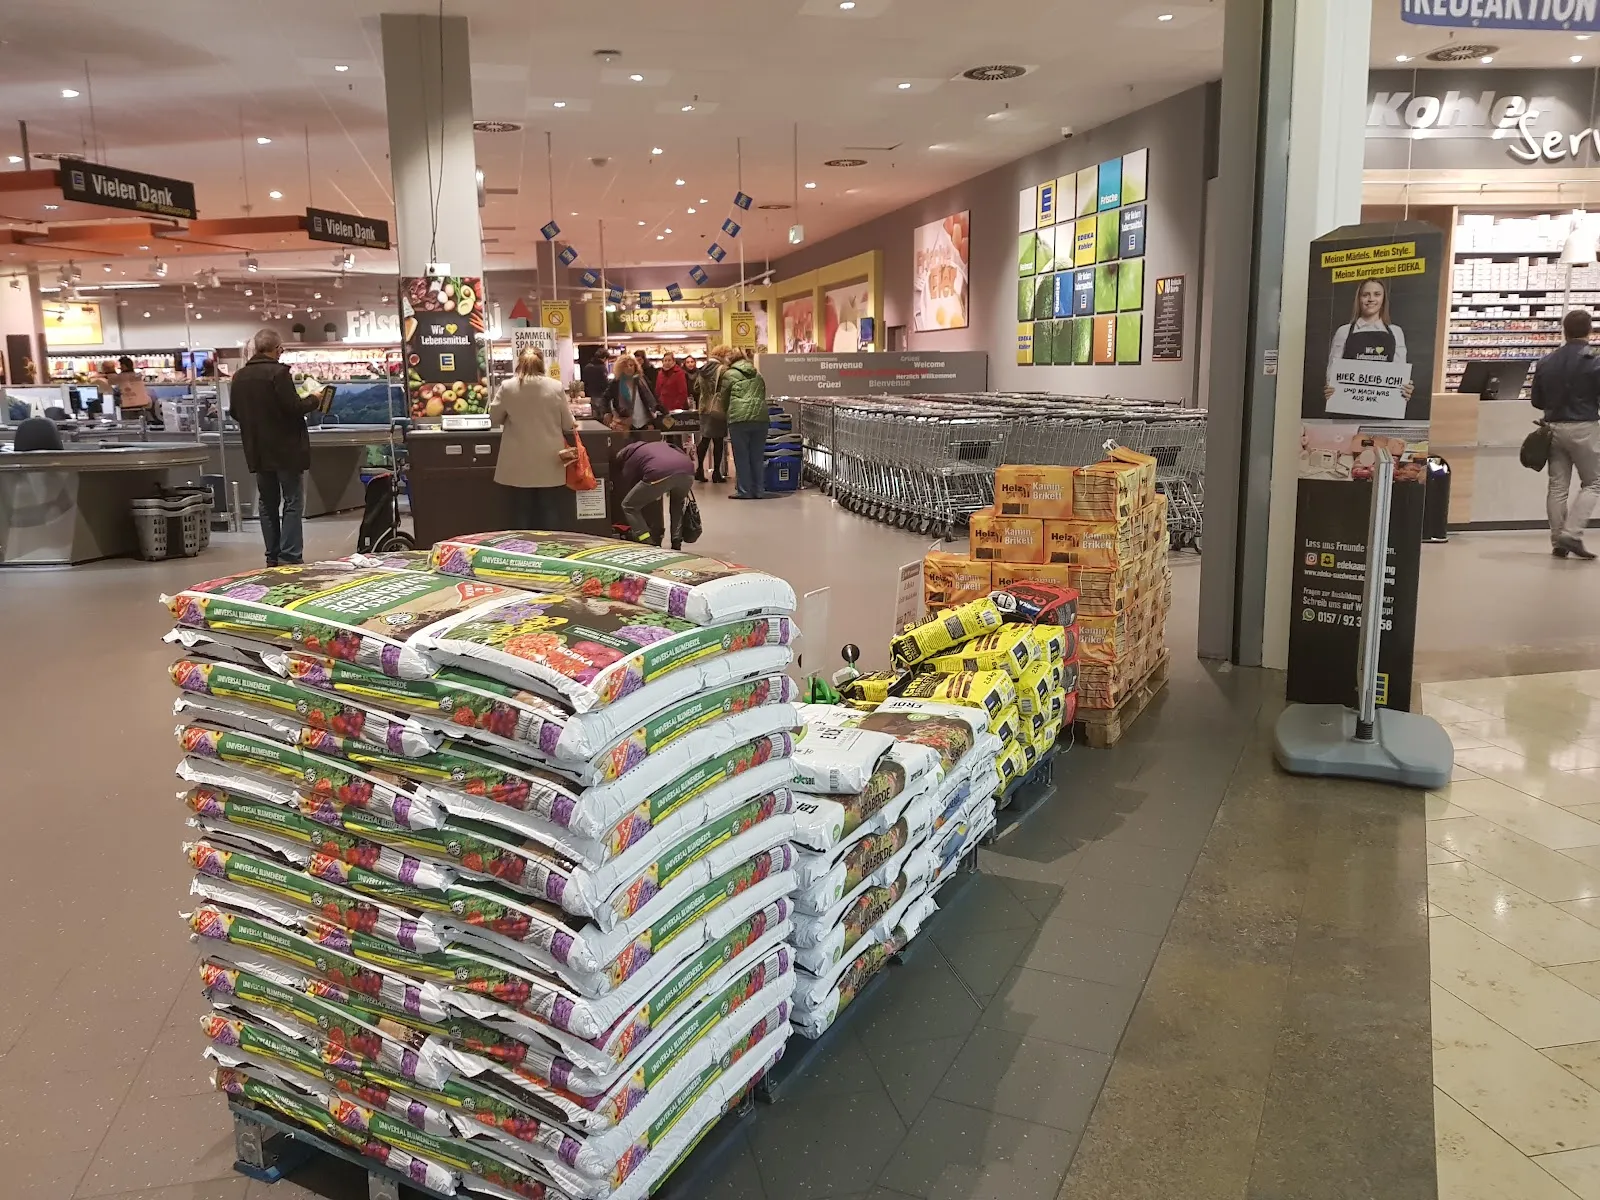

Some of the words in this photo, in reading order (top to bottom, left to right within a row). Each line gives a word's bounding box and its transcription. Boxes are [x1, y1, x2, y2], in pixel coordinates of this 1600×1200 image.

[92, 174, 137, 201] Vielen
[139, 182, 174, 207] Dank
[326, 218, 354, 238] Vielen
[355, 222, 376, 241] Dank
[1077, 232, 1094, 243] EDEKA
[1324, 255, 1345, 265] Meine
[1345, 252, 1372, 262] Mädels.
[1373, 249, 1391, 258] Mein
[1391, 247, 1412, 257] Style.
[1334, 270, 1356, 280] Meine
[1356, 267, 1385, 278] Karriere
[1385, 264, 1397, 273] bei
[430, 324, 446, 336] Wir
[514, 331, 553, 341] SAMMELN,
[421, 335, 472, 346] Lebensmittel.
[514, 340, 545, 349] SPAREN
[820, 361, 863, 370] Bienvenue
[914, 360, 946, 368] Welcome
[788, 374, 826, 383] Welcome
[868, 379, 911, 388] Bienvenue
[1336, 372, 1356, 382] HIER
[1358, 373, 1383, 385] BLEIB
[1385, 376, 1403, 386] ICH!
[1032, 491, 1063, 500] Brikett
[1004, 536, 1034, 545] Brikett
[1082, 540, 1112, 549] Brikett
[1322, 541, 1335, 550] uns
[1336, 541, 1365, 553] Freunde
[481, 556, 509, 566] UNIVERSAL
[1303, 586, 1321, 597] Fragen
[341, 585, 431, 615] UNIVERSAL
[1302, 596, 1328, 608] Schreib
[1328, 601, 1341, 609] uns
[1342, 602, 1354, 611] auf
[213, 607, 238, 620] UNIVERSAL
[1317, 611, 1337, 624] 0157
[1343, 614, 1355, 627] 92
[217, 674, 242, 688] UNIVERSAL
[226, 740, 250, 755] UNIVERSAL
[233, 803, 257, 817] UNIVERSAL
[234, 861, 258, 876] UNIVERSAL
[238, 924, 263, 940] UNIVERSAL
[651, 1045, 676, 1074] UNIVERSAL
[378, 1119, 407, 1136] UNIVERSAL
